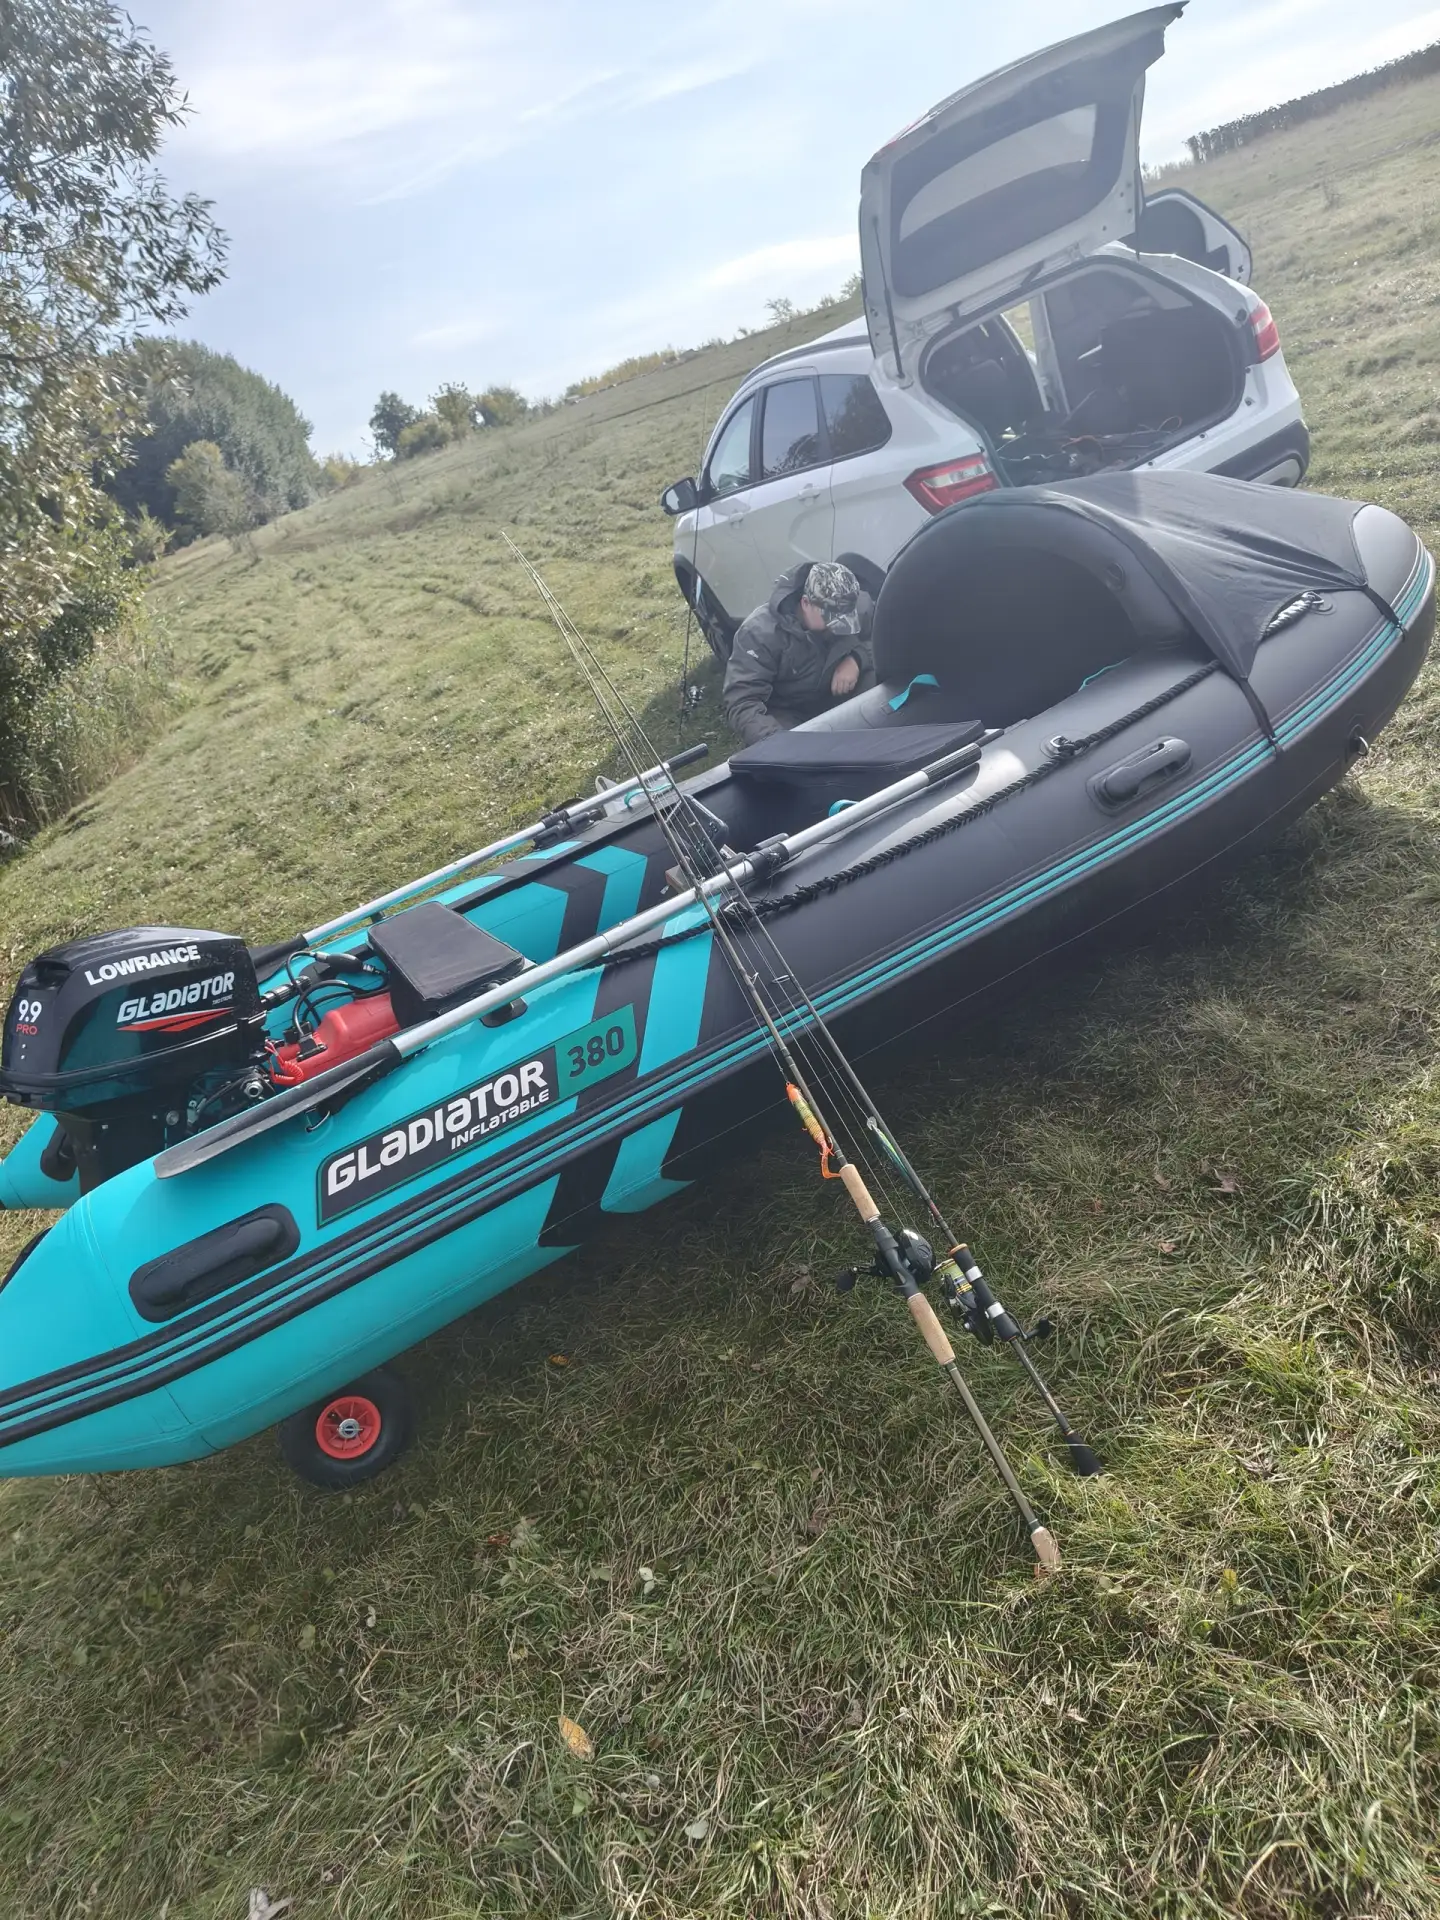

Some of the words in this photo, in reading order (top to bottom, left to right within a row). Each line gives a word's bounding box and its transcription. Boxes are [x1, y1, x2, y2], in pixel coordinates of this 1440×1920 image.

[84, 945, 201, 986] LOWRANCE
[18, 999, 42, 1023] 9.9
[16, 1023, 38, 1035] PRO
[566, 1025, 625, 1079] 380
